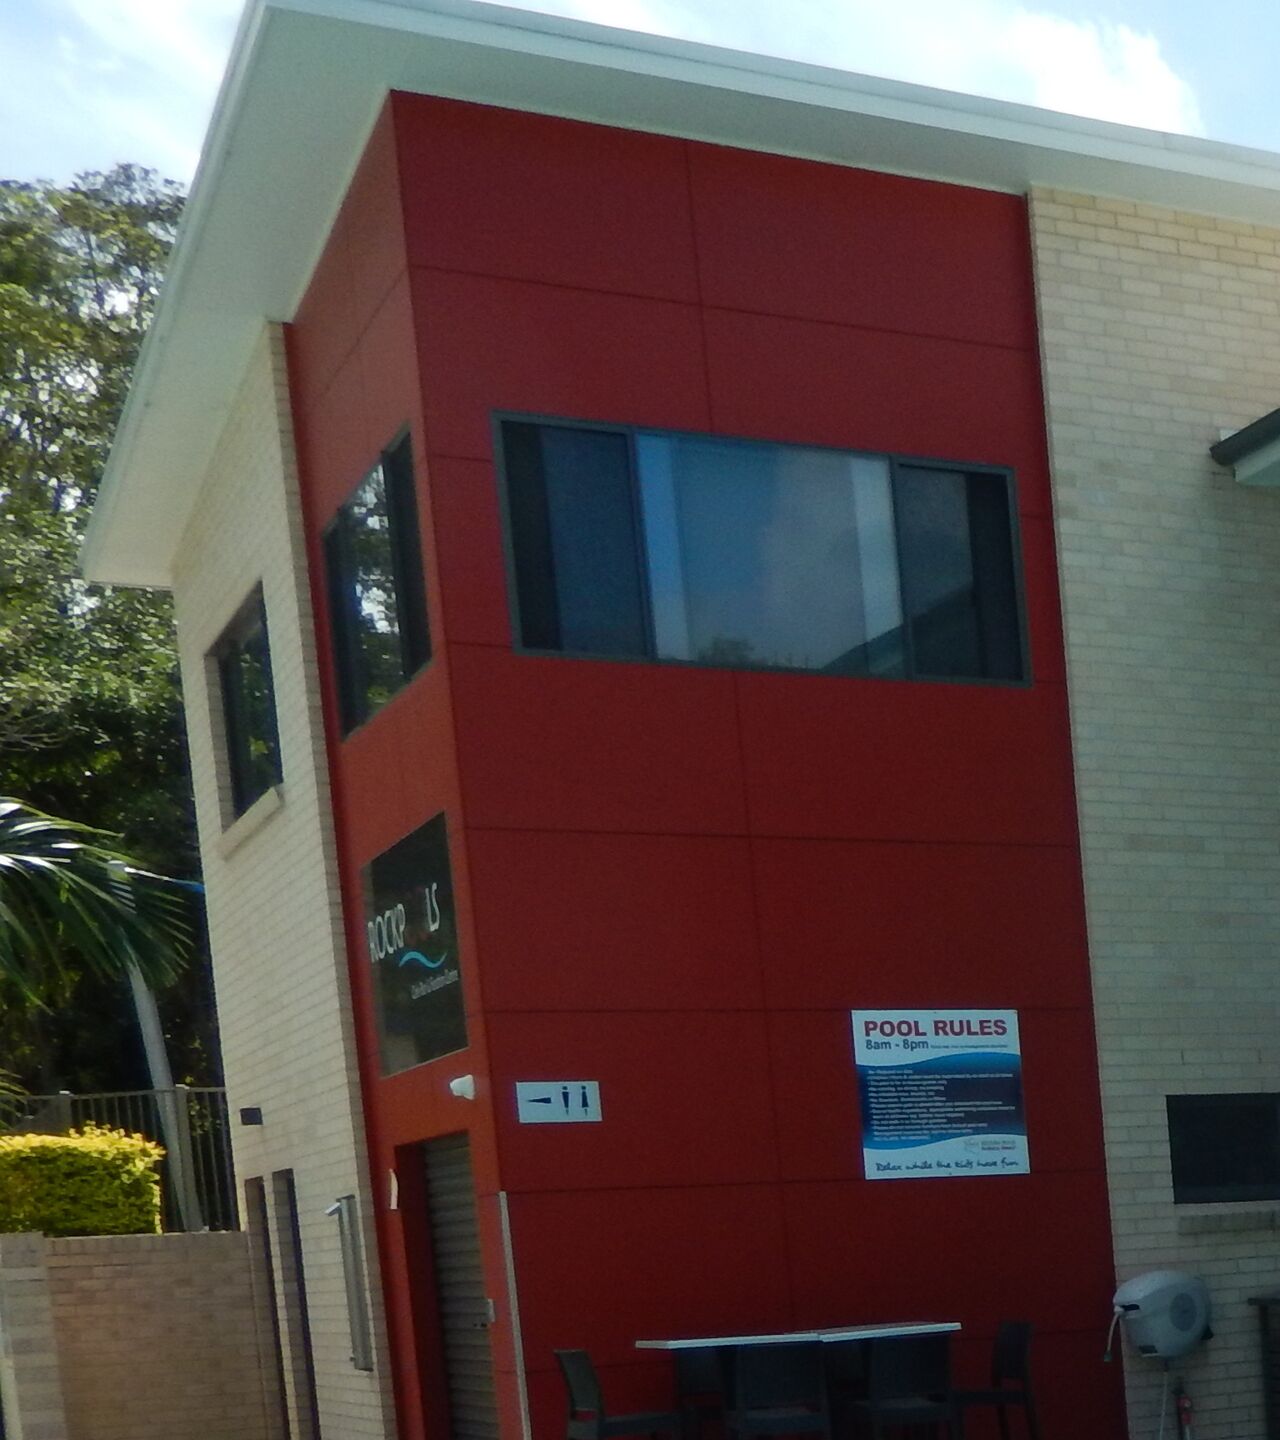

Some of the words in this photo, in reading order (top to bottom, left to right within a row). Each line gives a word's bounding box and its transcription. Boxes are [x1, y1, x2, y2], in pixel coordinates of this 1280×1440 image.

[864, 1020, 927, 1037] POOL
[934, 1019, 1008, 1036] RULES
[866, 1039, 892, 1050] 8am
[903, 1038, 929, 1052] 8pm
[876, 1162, 903, 1171] Relax
[906, 1160, 933, 1170] while
[936, 1159, 952, 1168] the
[977, 1160, 998, 1168] have
[1001, 1157, 1019, 1169] fun
